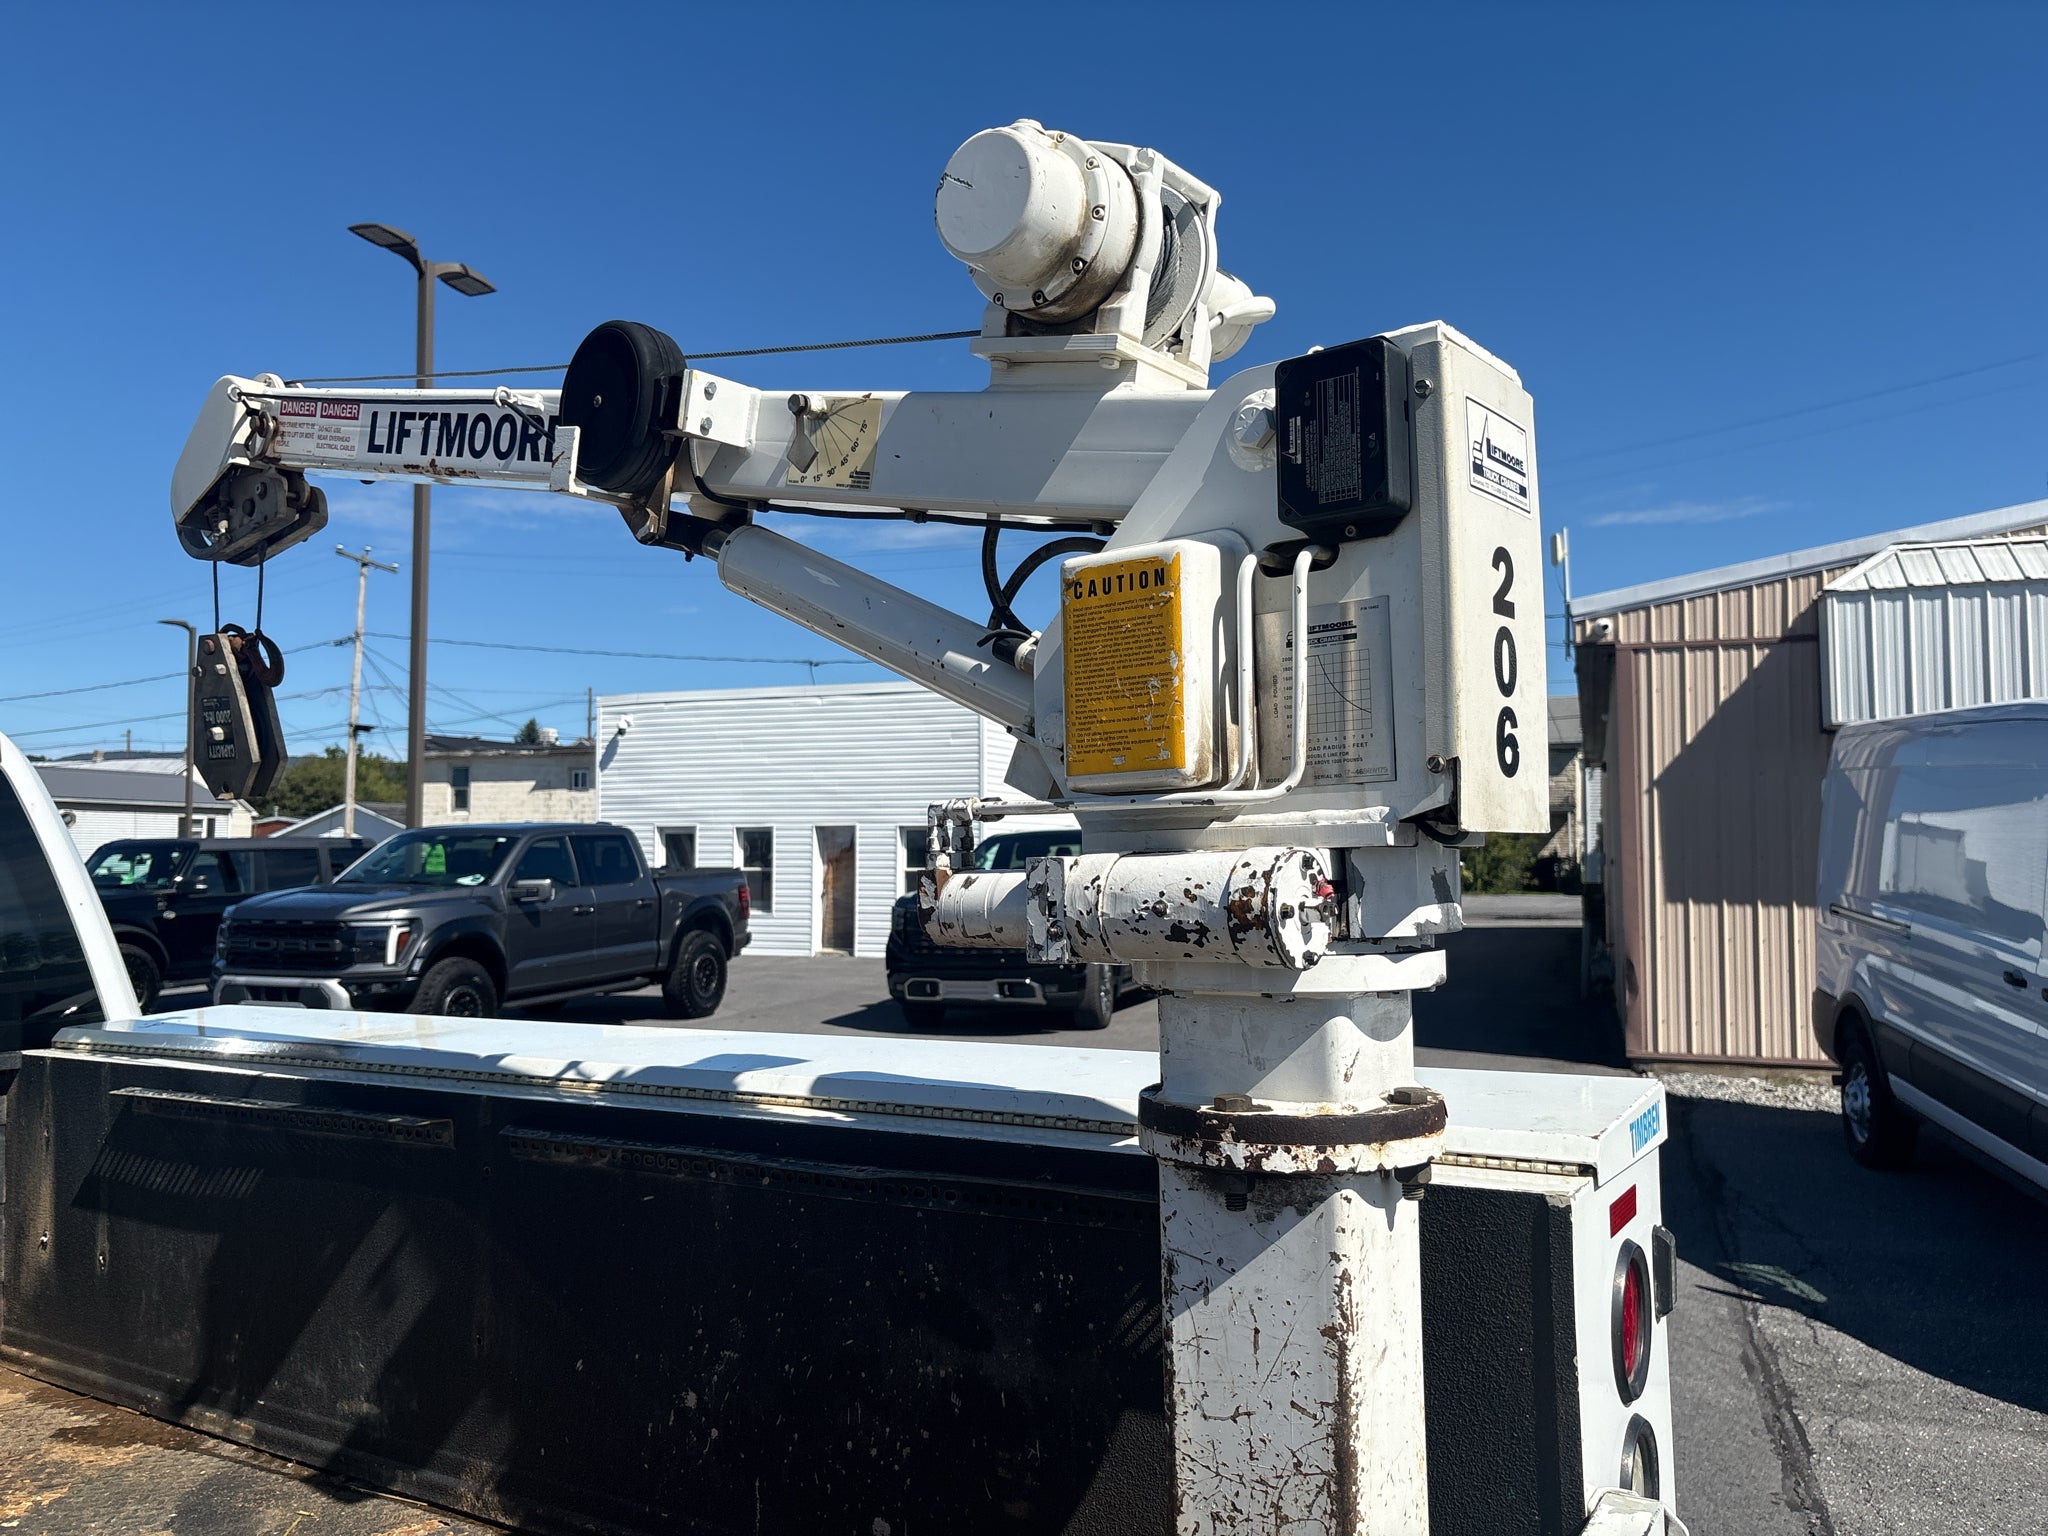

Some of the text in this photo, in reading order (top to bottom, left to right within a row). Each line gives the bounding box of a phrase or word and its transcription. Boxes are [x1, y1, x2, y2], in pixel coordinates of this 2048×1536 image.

[282, 401, 316, 414] DANGER
[322, 403, 359, 417] DANGER
[1486, 437, 1526, 478] LIFTMOORE
[1073, 568, 1165, 600] CAUTION
[209, 744, 235, 758] CAPACITY
[229, 938, 342, 952] FORD
[1630, 1101, 1660, 1158] TIMBREN
